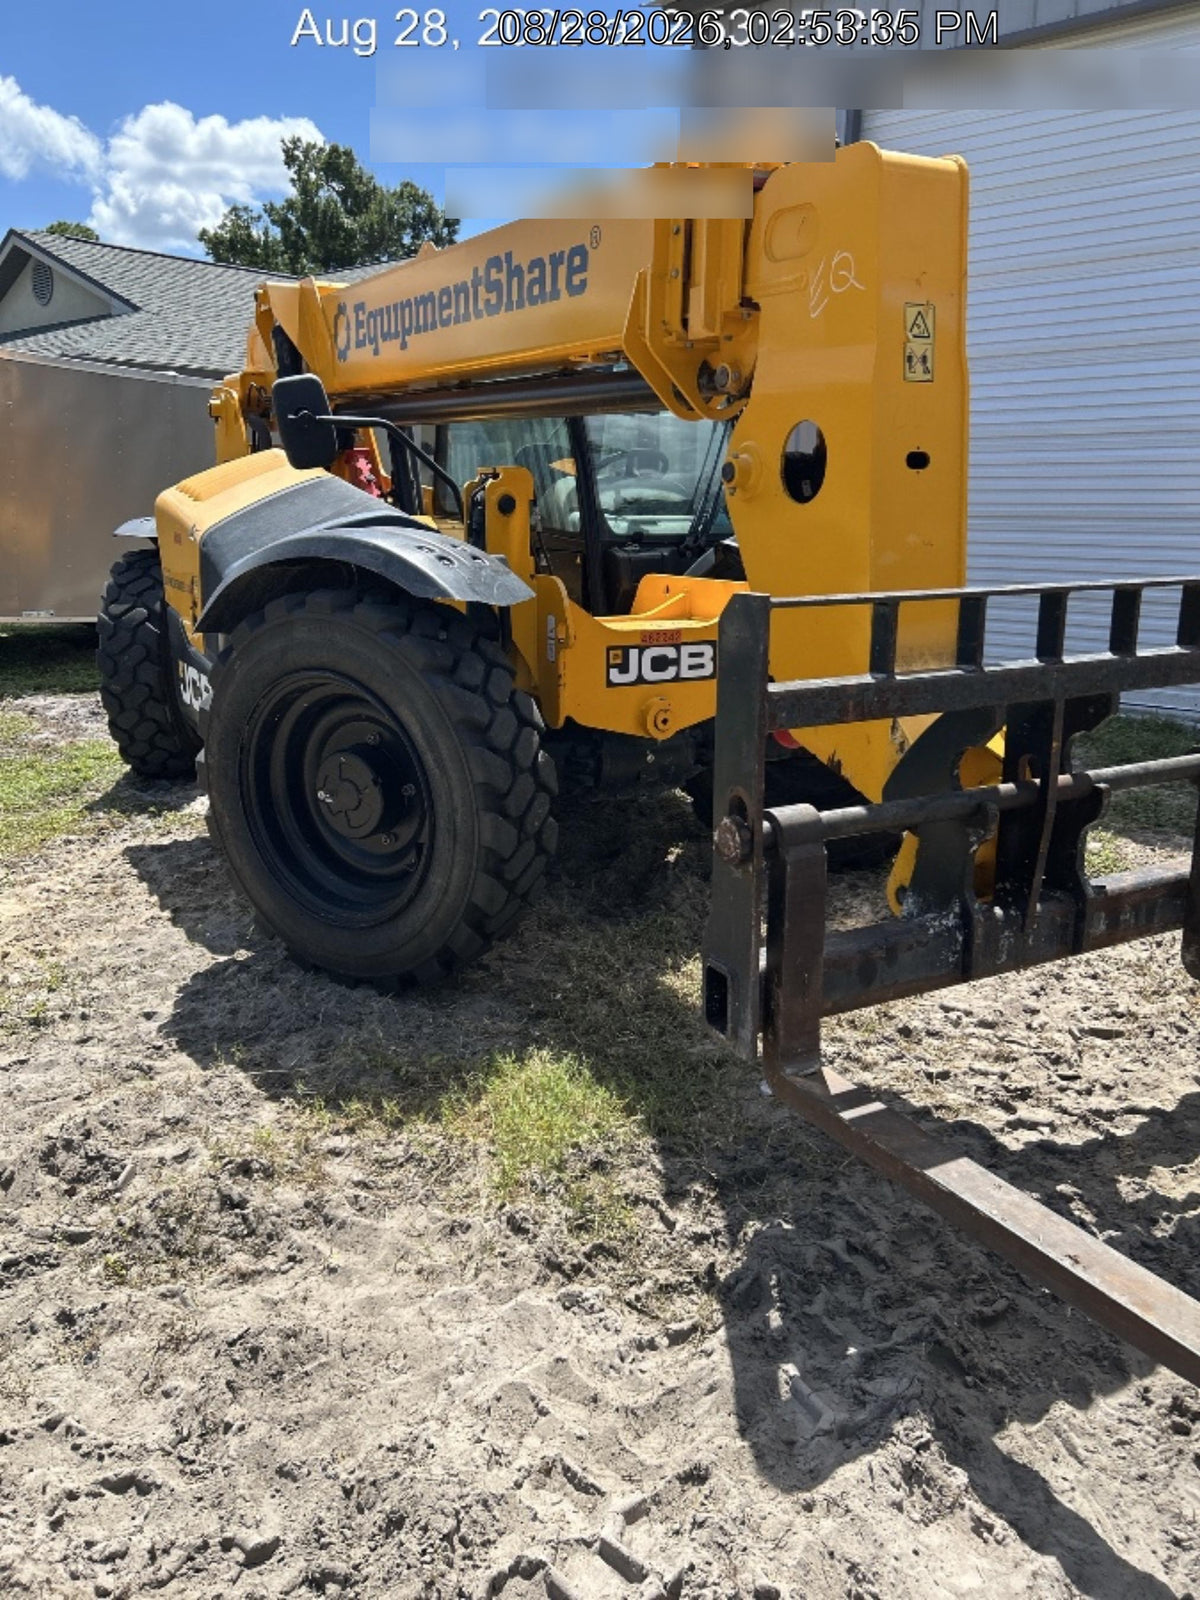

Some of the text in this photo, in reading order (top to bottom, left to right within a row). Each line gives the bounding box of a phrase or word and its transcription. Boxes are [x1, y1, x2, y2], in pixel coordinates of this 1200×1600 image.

[353, 243, 590, 357] EquipmentShare
[180, 662, 214, 712] JCB
[609, 644, 714, 684] JCB
